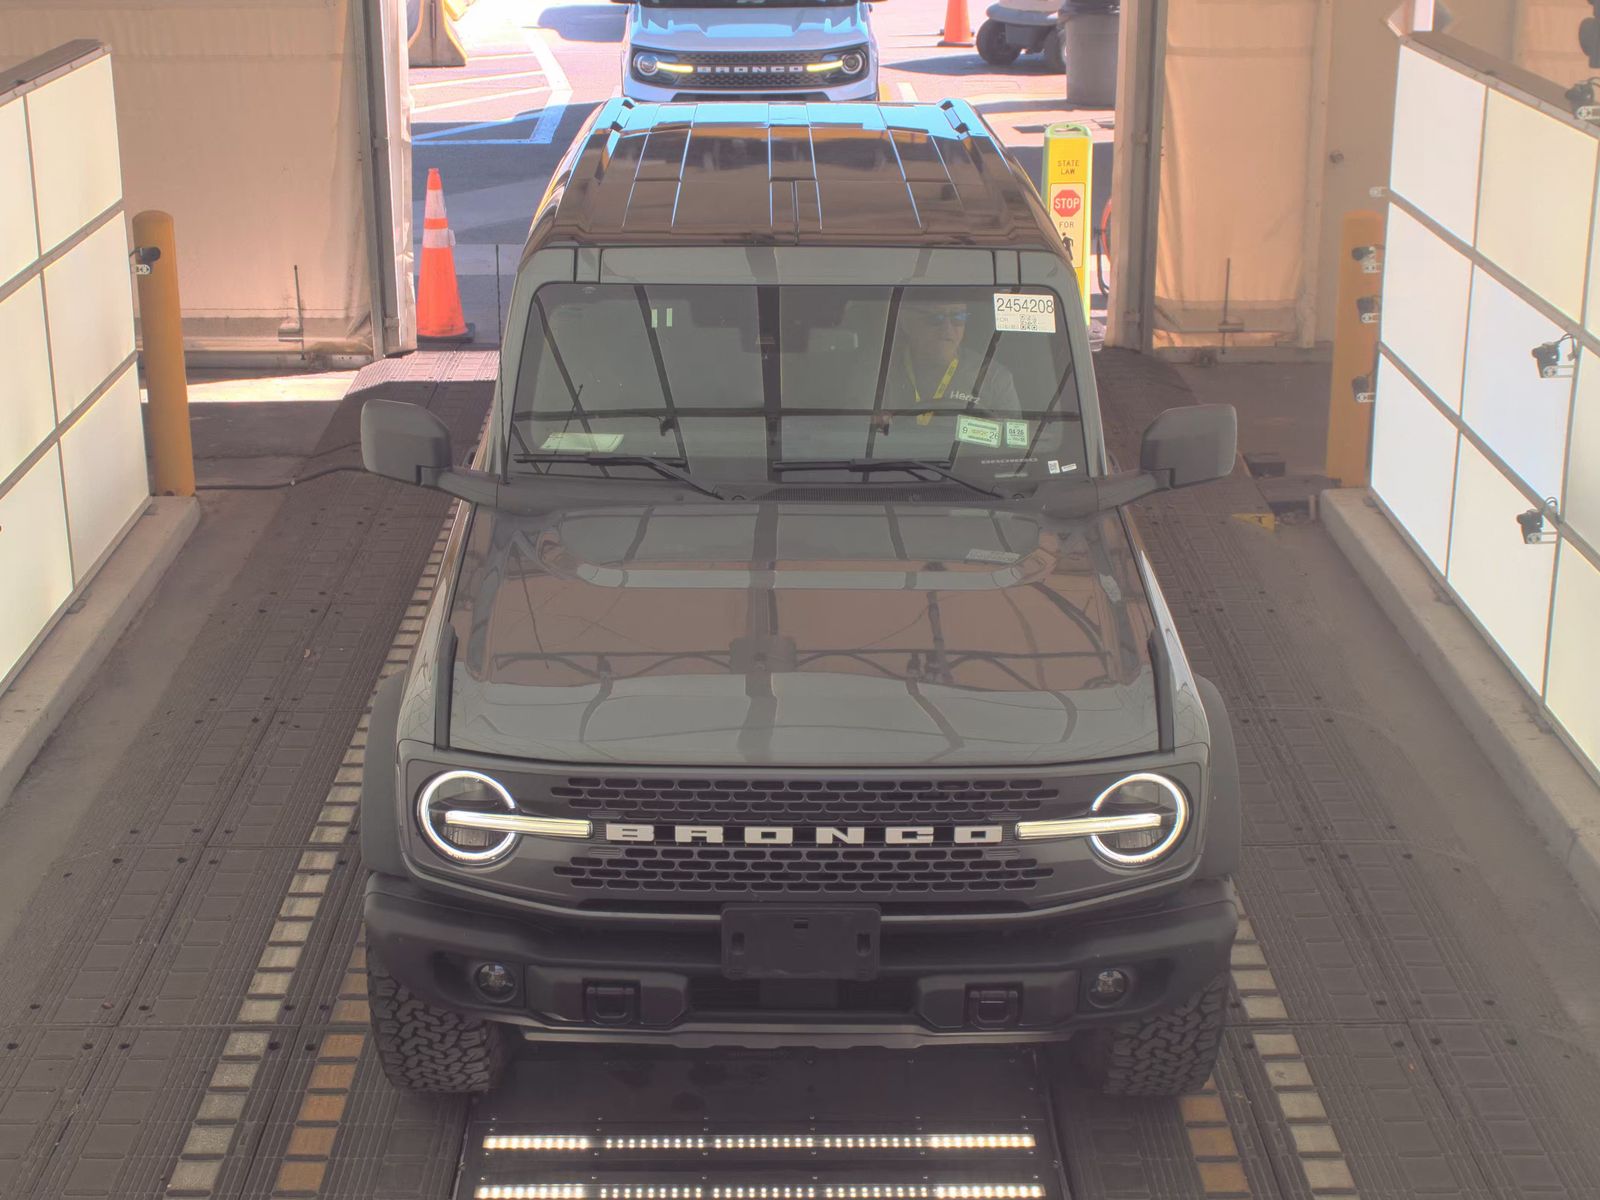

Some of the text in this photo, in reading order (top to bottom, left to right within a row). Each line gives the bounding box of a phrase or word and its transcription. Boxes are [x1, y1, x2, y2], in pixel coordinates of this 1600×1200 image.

[697, 65, 803, 73] BRONCO
[1054, 197, 1080, 209] STOP
[996, 297, 1054, 313] 2454208
[988, 431, 1000, 440] 26
[606, 823, 1003, 844] BRONCO
